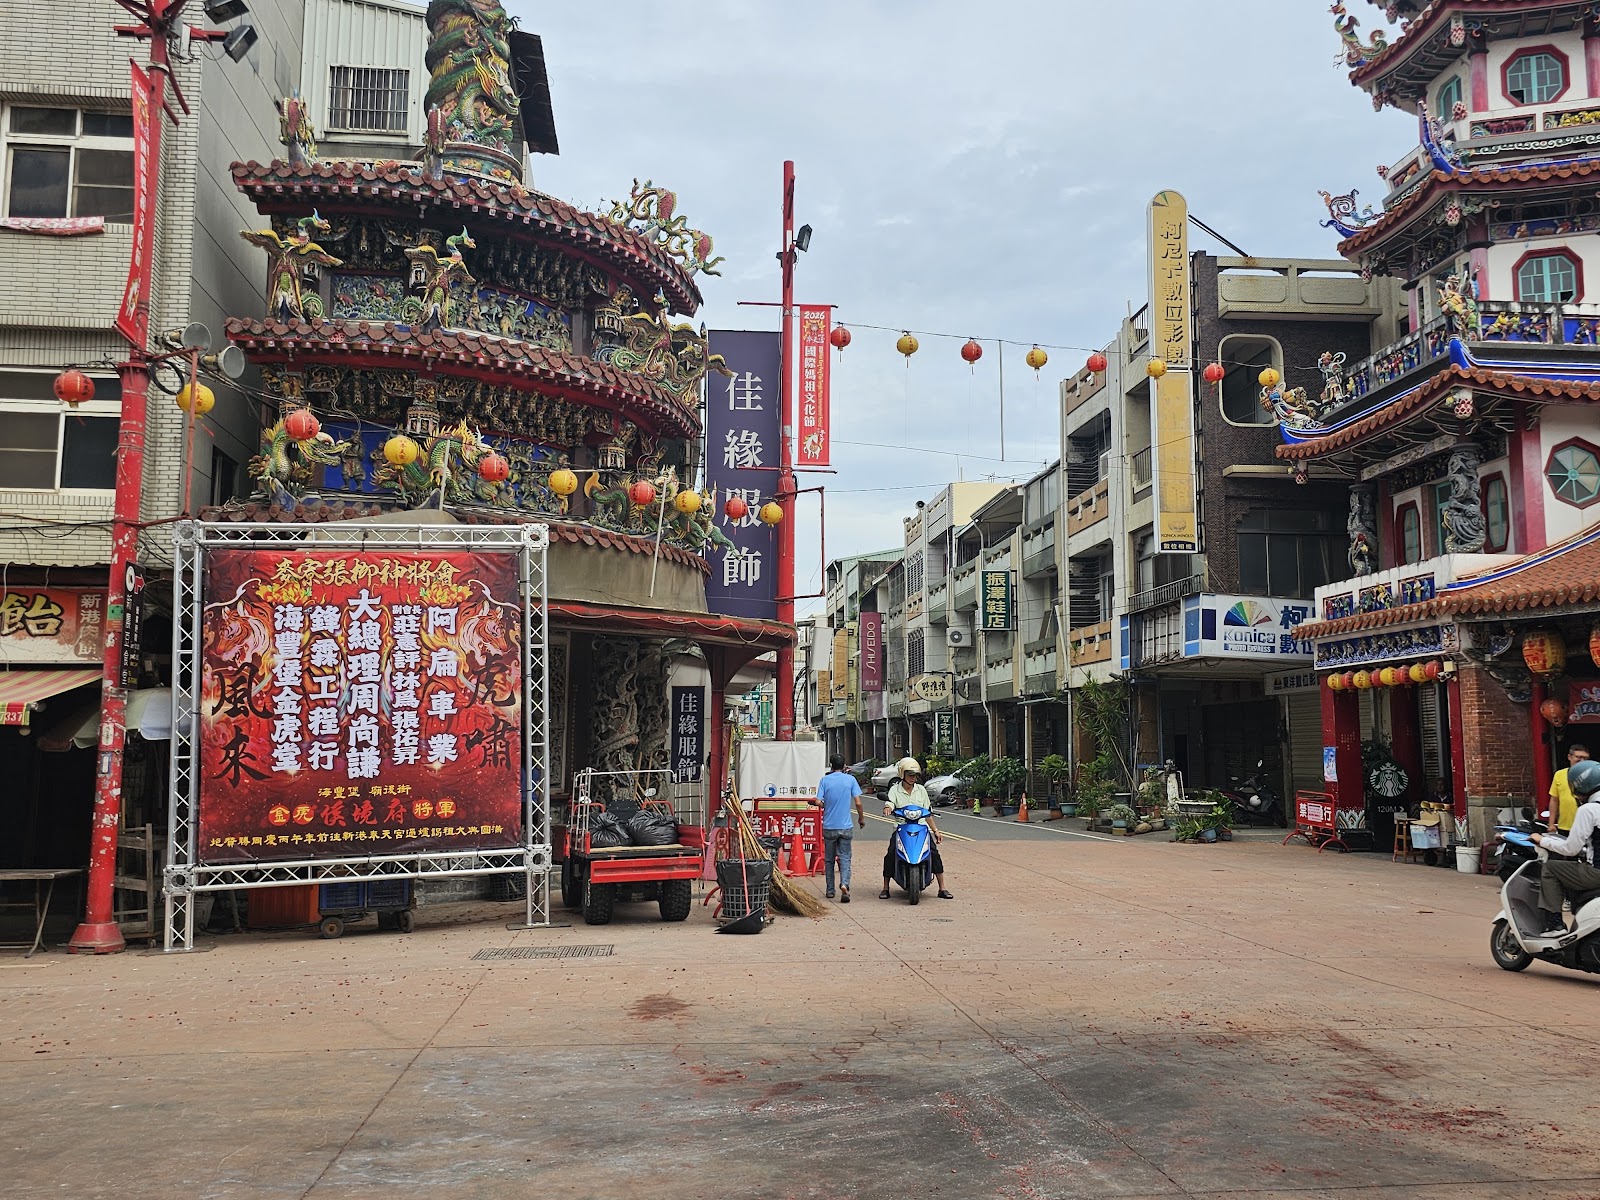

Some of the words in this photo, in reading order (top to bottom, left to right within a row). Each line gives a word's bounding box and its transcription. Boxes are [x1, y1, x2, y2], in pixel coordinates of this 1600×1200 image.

[804, 311, 825, 319] 2026
[804, 345, 816, 427] 國際媽祖文化節
[722, 371, 763, 587] 佳緣服飾
[392, 604, 422, 614] 副會長
[985, 572, 1006, 628] 振澤鞋店
[866, 622, 877, 674] SHISEIDO
[1224, 629, 1275, 643] Konica
[271, 603, 305, 772] 海豐堡金虎堂
[308, 605, 341, 770] 鋒霖工程行
[346, 588, 382, 779] 大總理周尚謙
[427, 606, 459, 763] 阿扁車業
[211, 661, 275, 789] 風來
[678, 692, 697, 778] 佳緣服飾
[270, 806, 314, 823] 金虎
[414, 801, 456, 818] 將軍
[318, 786, 360, 799] 海豐堡
[780, 786, 817, 795] 中華電信
